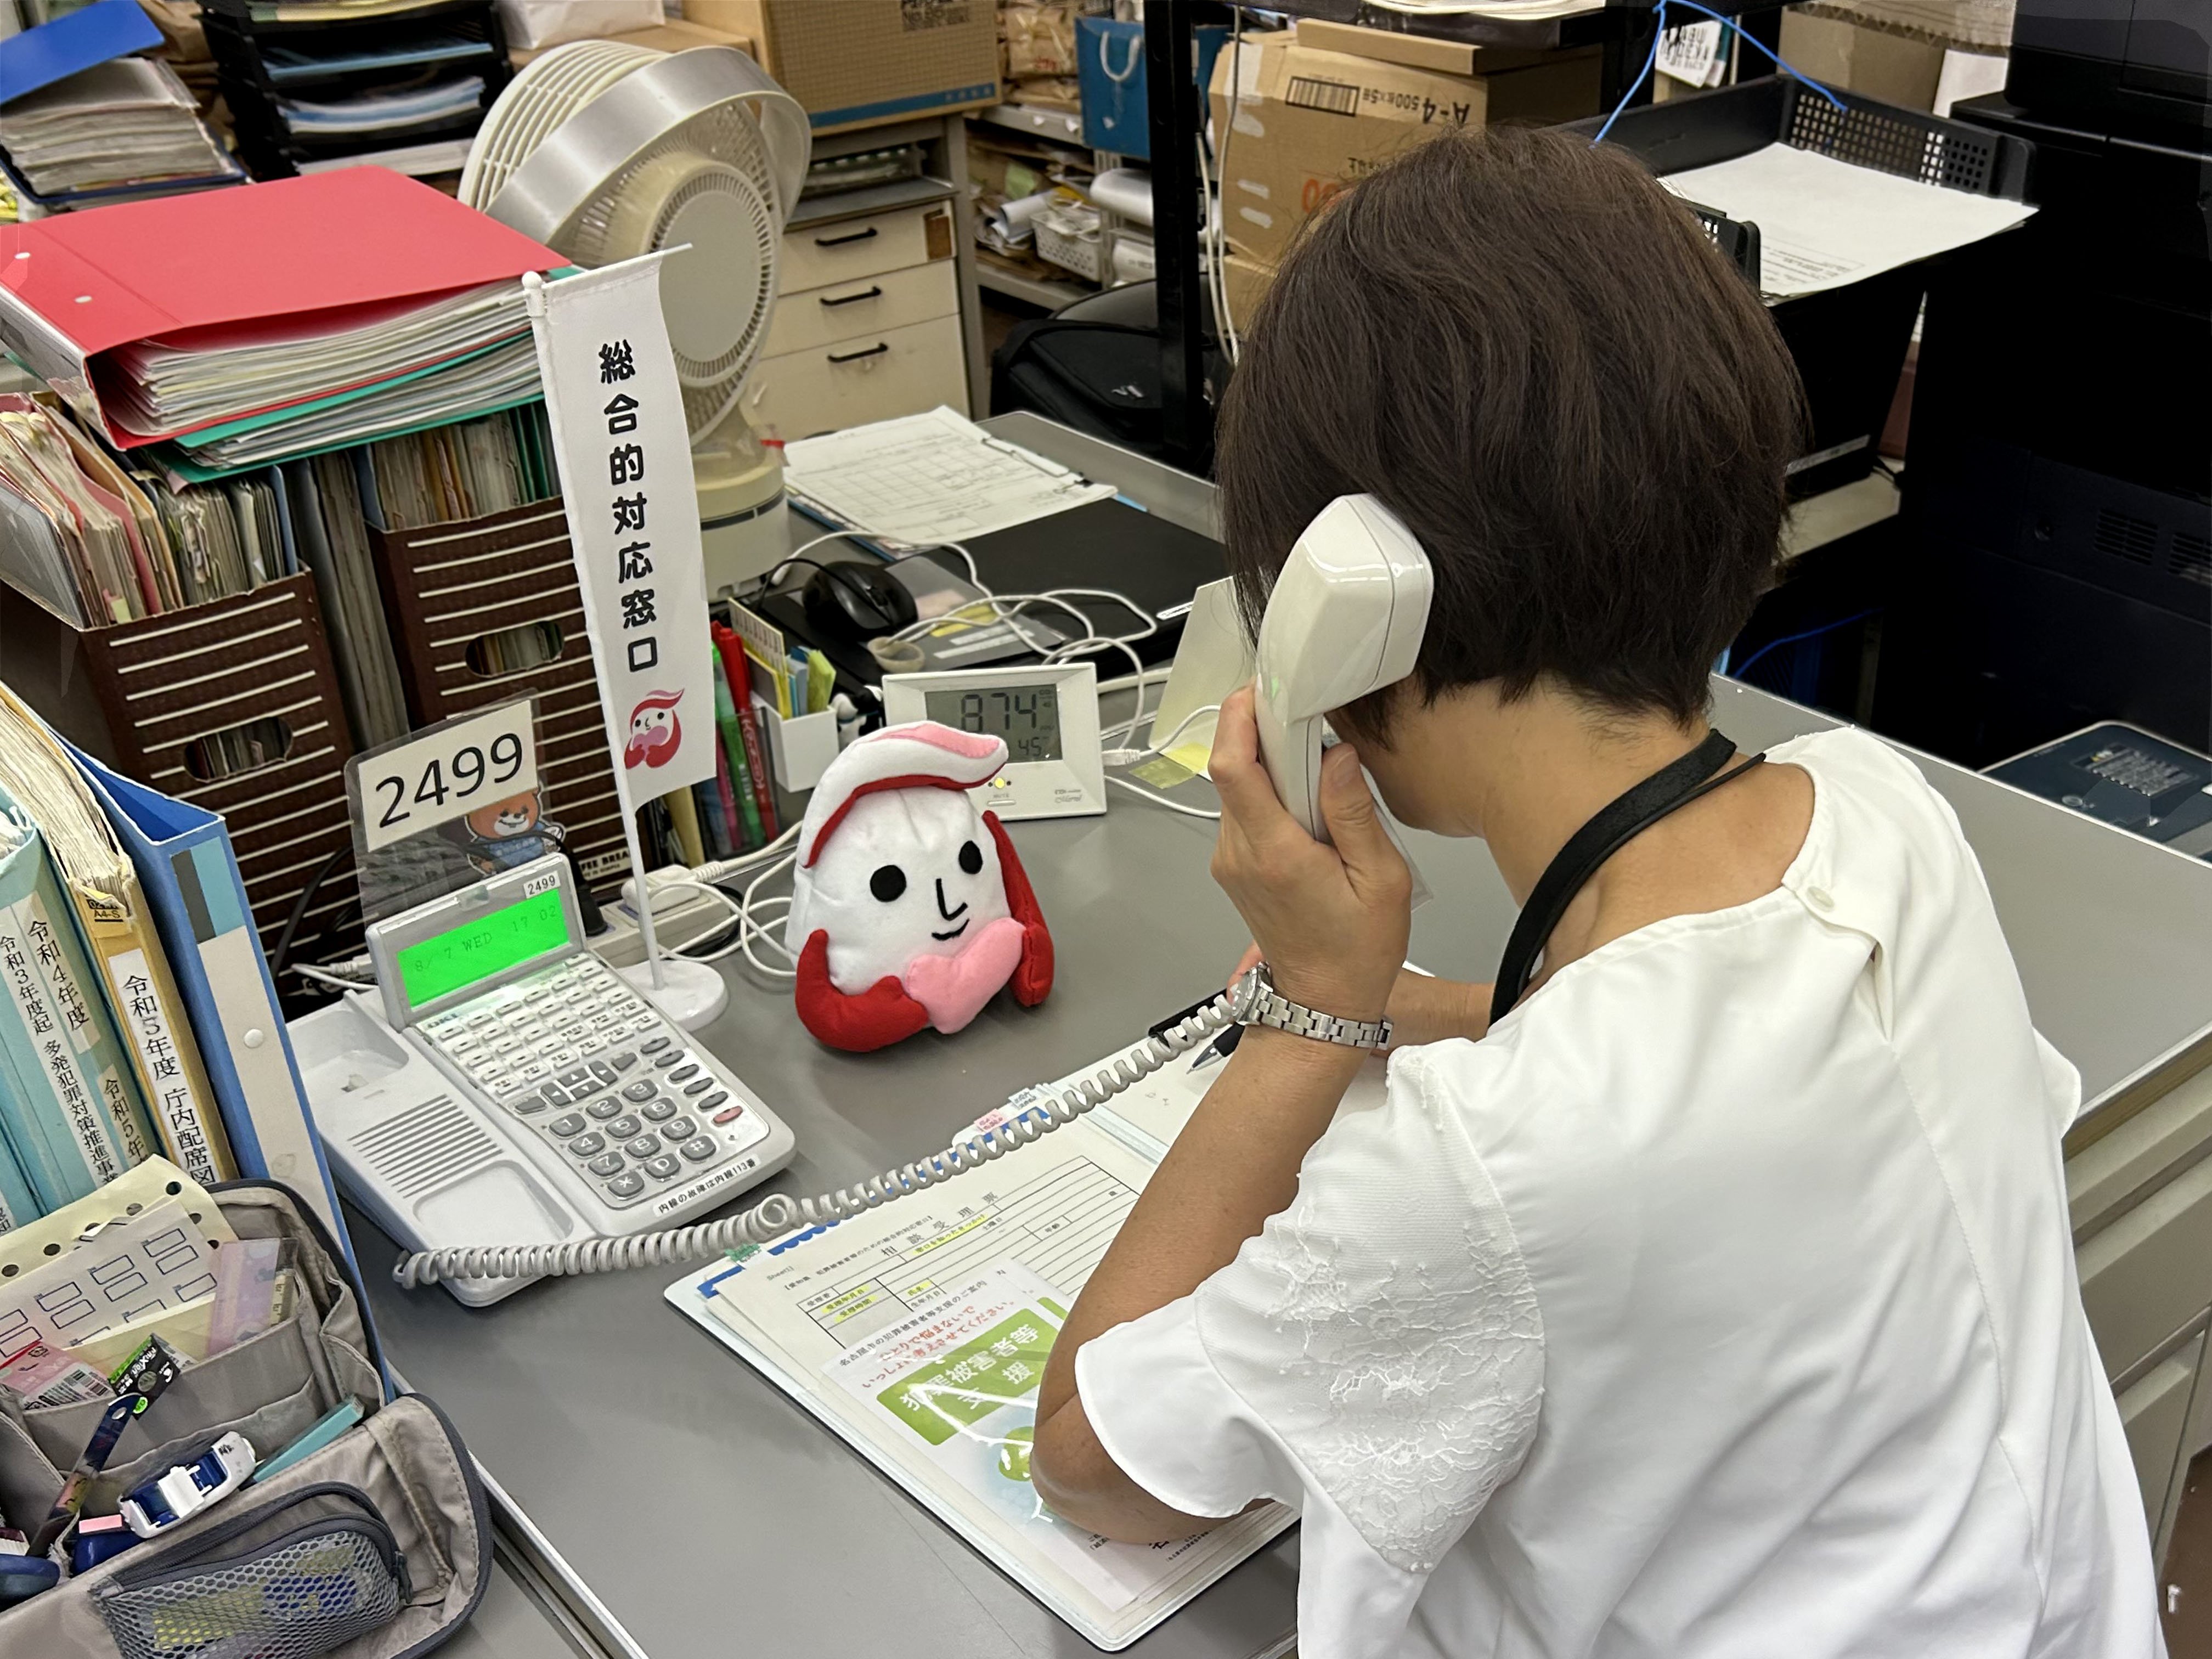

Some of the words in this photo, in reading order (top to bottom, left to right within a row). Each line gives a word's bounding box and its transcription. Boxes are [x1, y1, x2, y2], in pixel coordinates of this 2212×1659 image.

[598, 339, 659, 673] 総合的対応窓口
[961, 692, 1037, 733] 874
[1018, 736, 1042, 757] 45
[375, 732, 523, 828] 2499
[94, 909, 121, 918] A4-S
[527, 874, 556, 895] 2499
[462, 932, 492, 952] WED
[0, 935, 54, 1036] 令和3年度起
[28, 920, 90, 1031] 令和4年度
[427, 1013, 459, 1029] OKI
[123, 974, 180, 1081] 令和5年度
[163, 1087, 217, 1185] 庁内配席図
[104, 1079, 149, 1164] 令和5年
